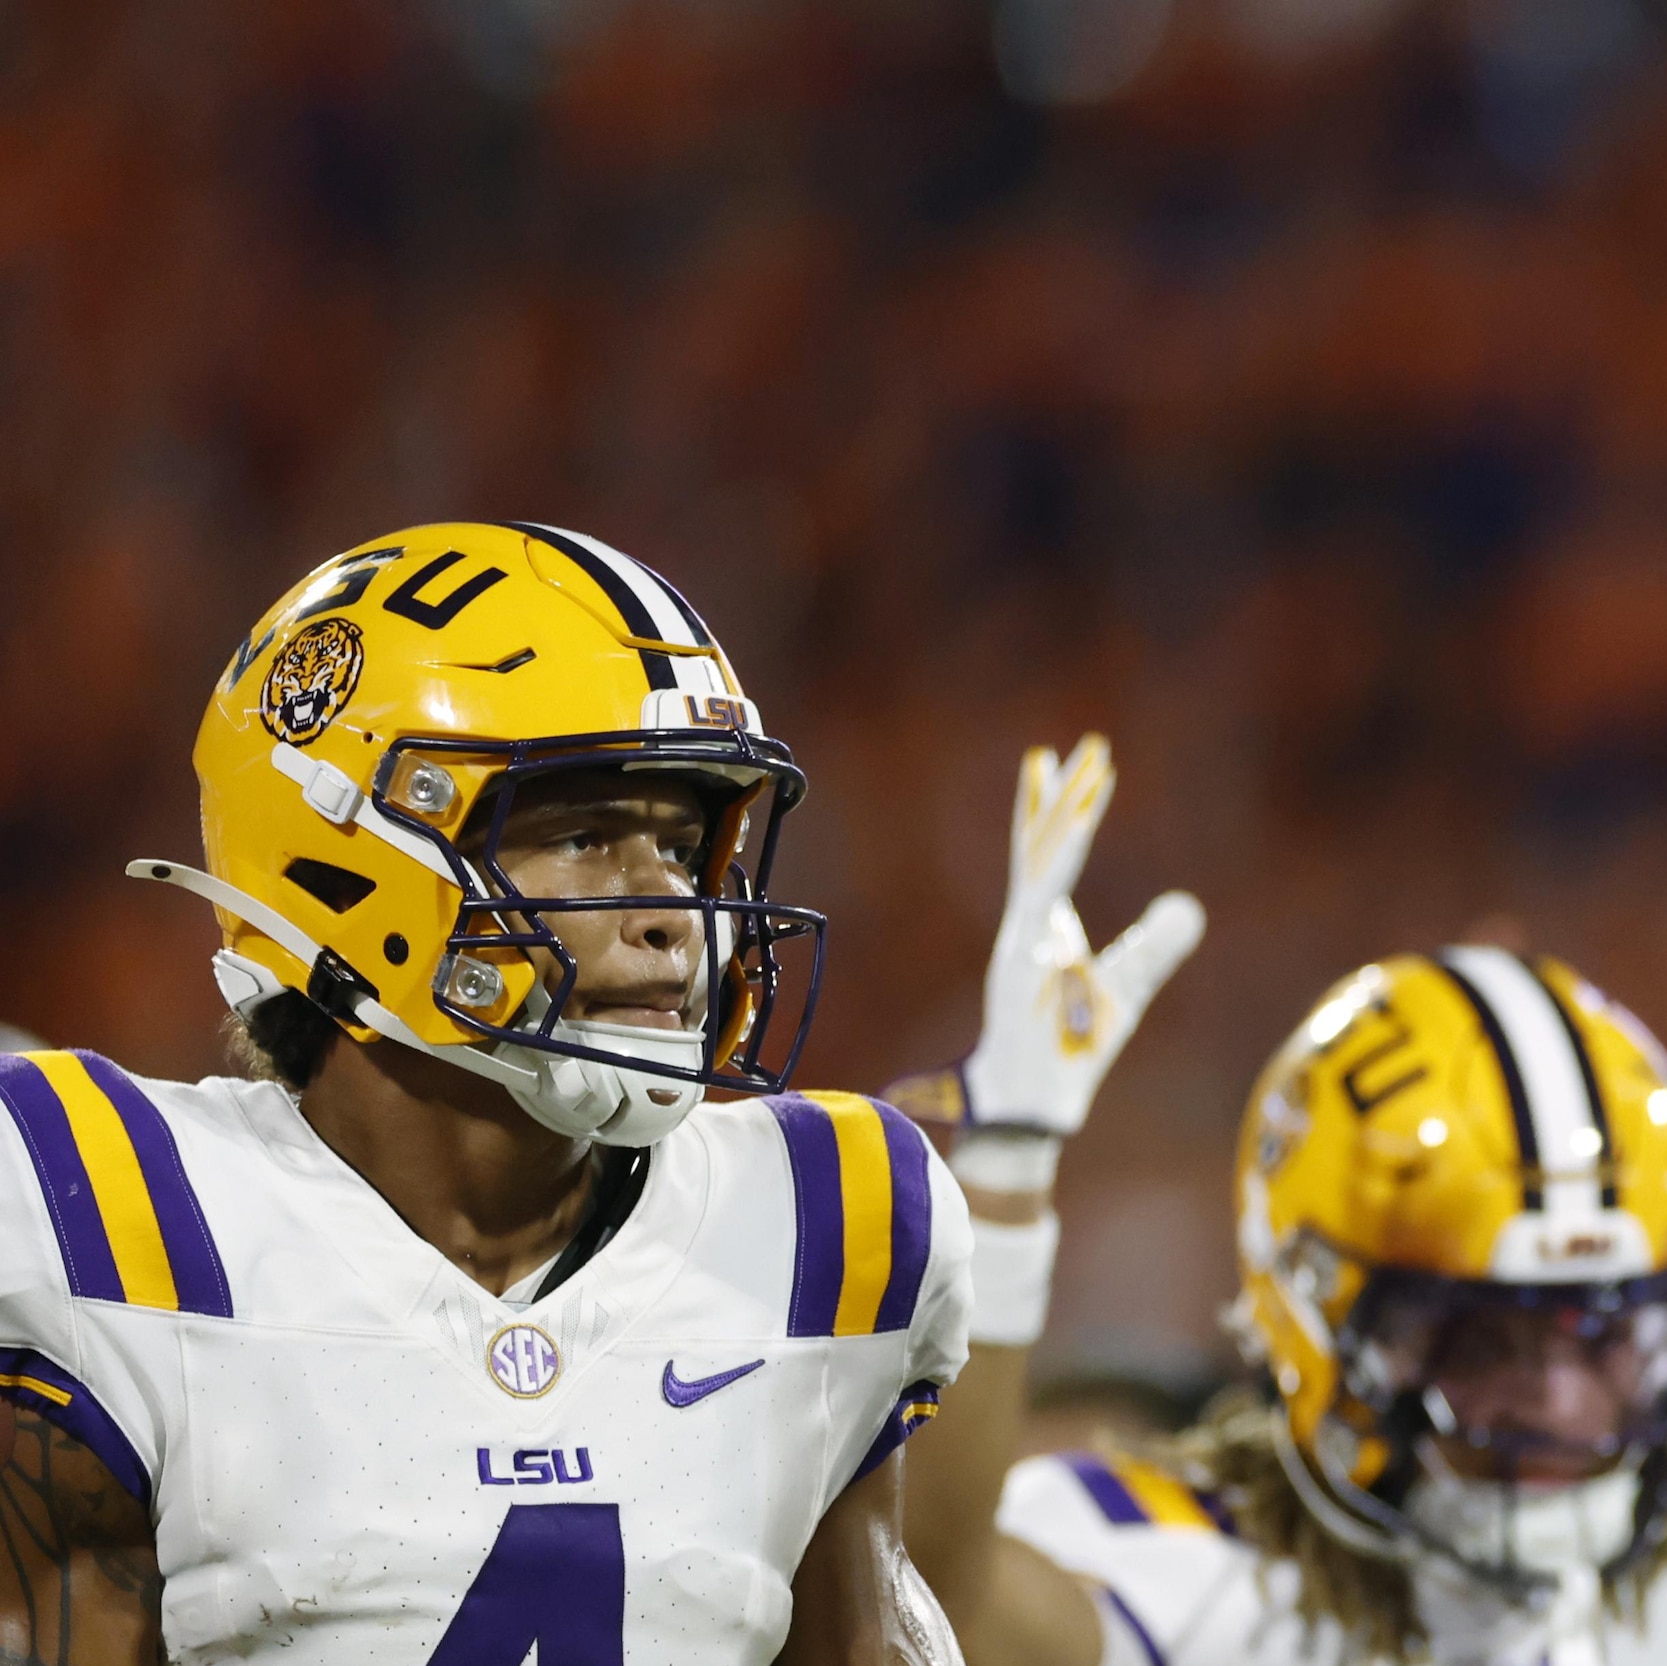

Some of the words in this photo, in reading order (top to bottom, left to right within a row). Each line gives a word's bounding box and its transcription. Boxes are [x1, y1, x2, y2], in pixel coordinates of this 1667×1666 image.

[684, 695, 749, 730] LSU
[492, 1327, 558, 1393] SEC
[477, 1447, 594, 1485] LSU
